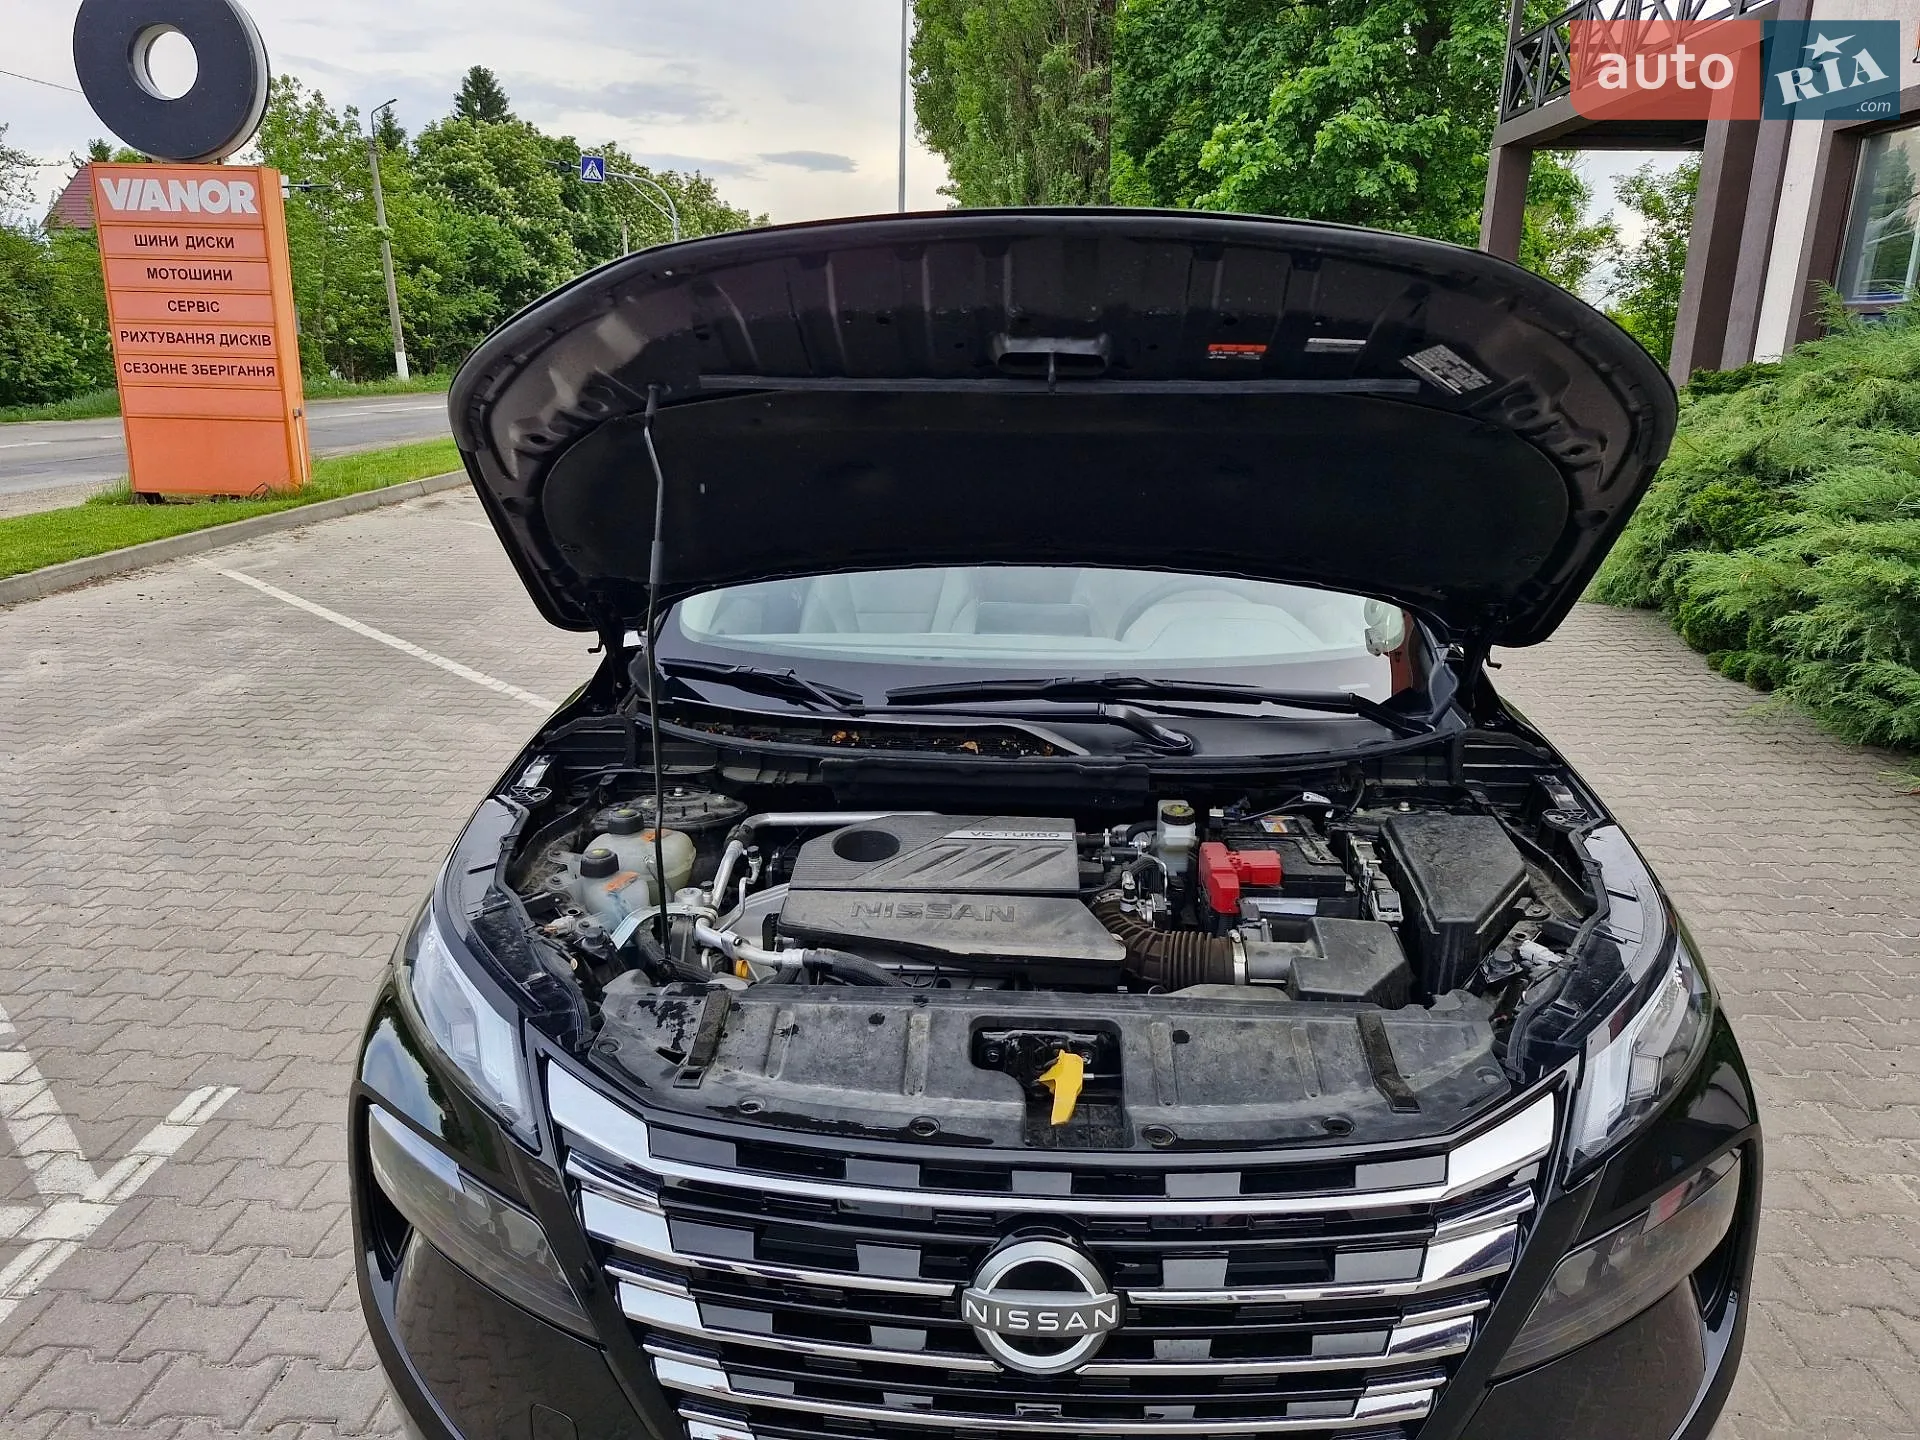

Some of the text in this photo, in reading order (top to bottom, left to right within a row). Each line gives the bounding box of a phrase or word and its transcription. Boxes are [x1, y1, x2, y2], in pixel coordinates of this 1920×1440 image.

[100, 178, 258, 214] VIANOR
[134, 234, 235, 250] ШИНИ ДИСКИ
[146, 267, 233, 281] МОТОШИНИ
[167, 300, 220, 313] СЕРВІС
[120, 330, 272, 347] РИХТУВАННЯ ДИСКІВ
[123, 362, 275, 377] СЕЗОННЕ ЗБЕРІГАННЯ
[850, 902, 1016, 922] NISSAN
[966, 1299, 1117, 1331] NISSAN
